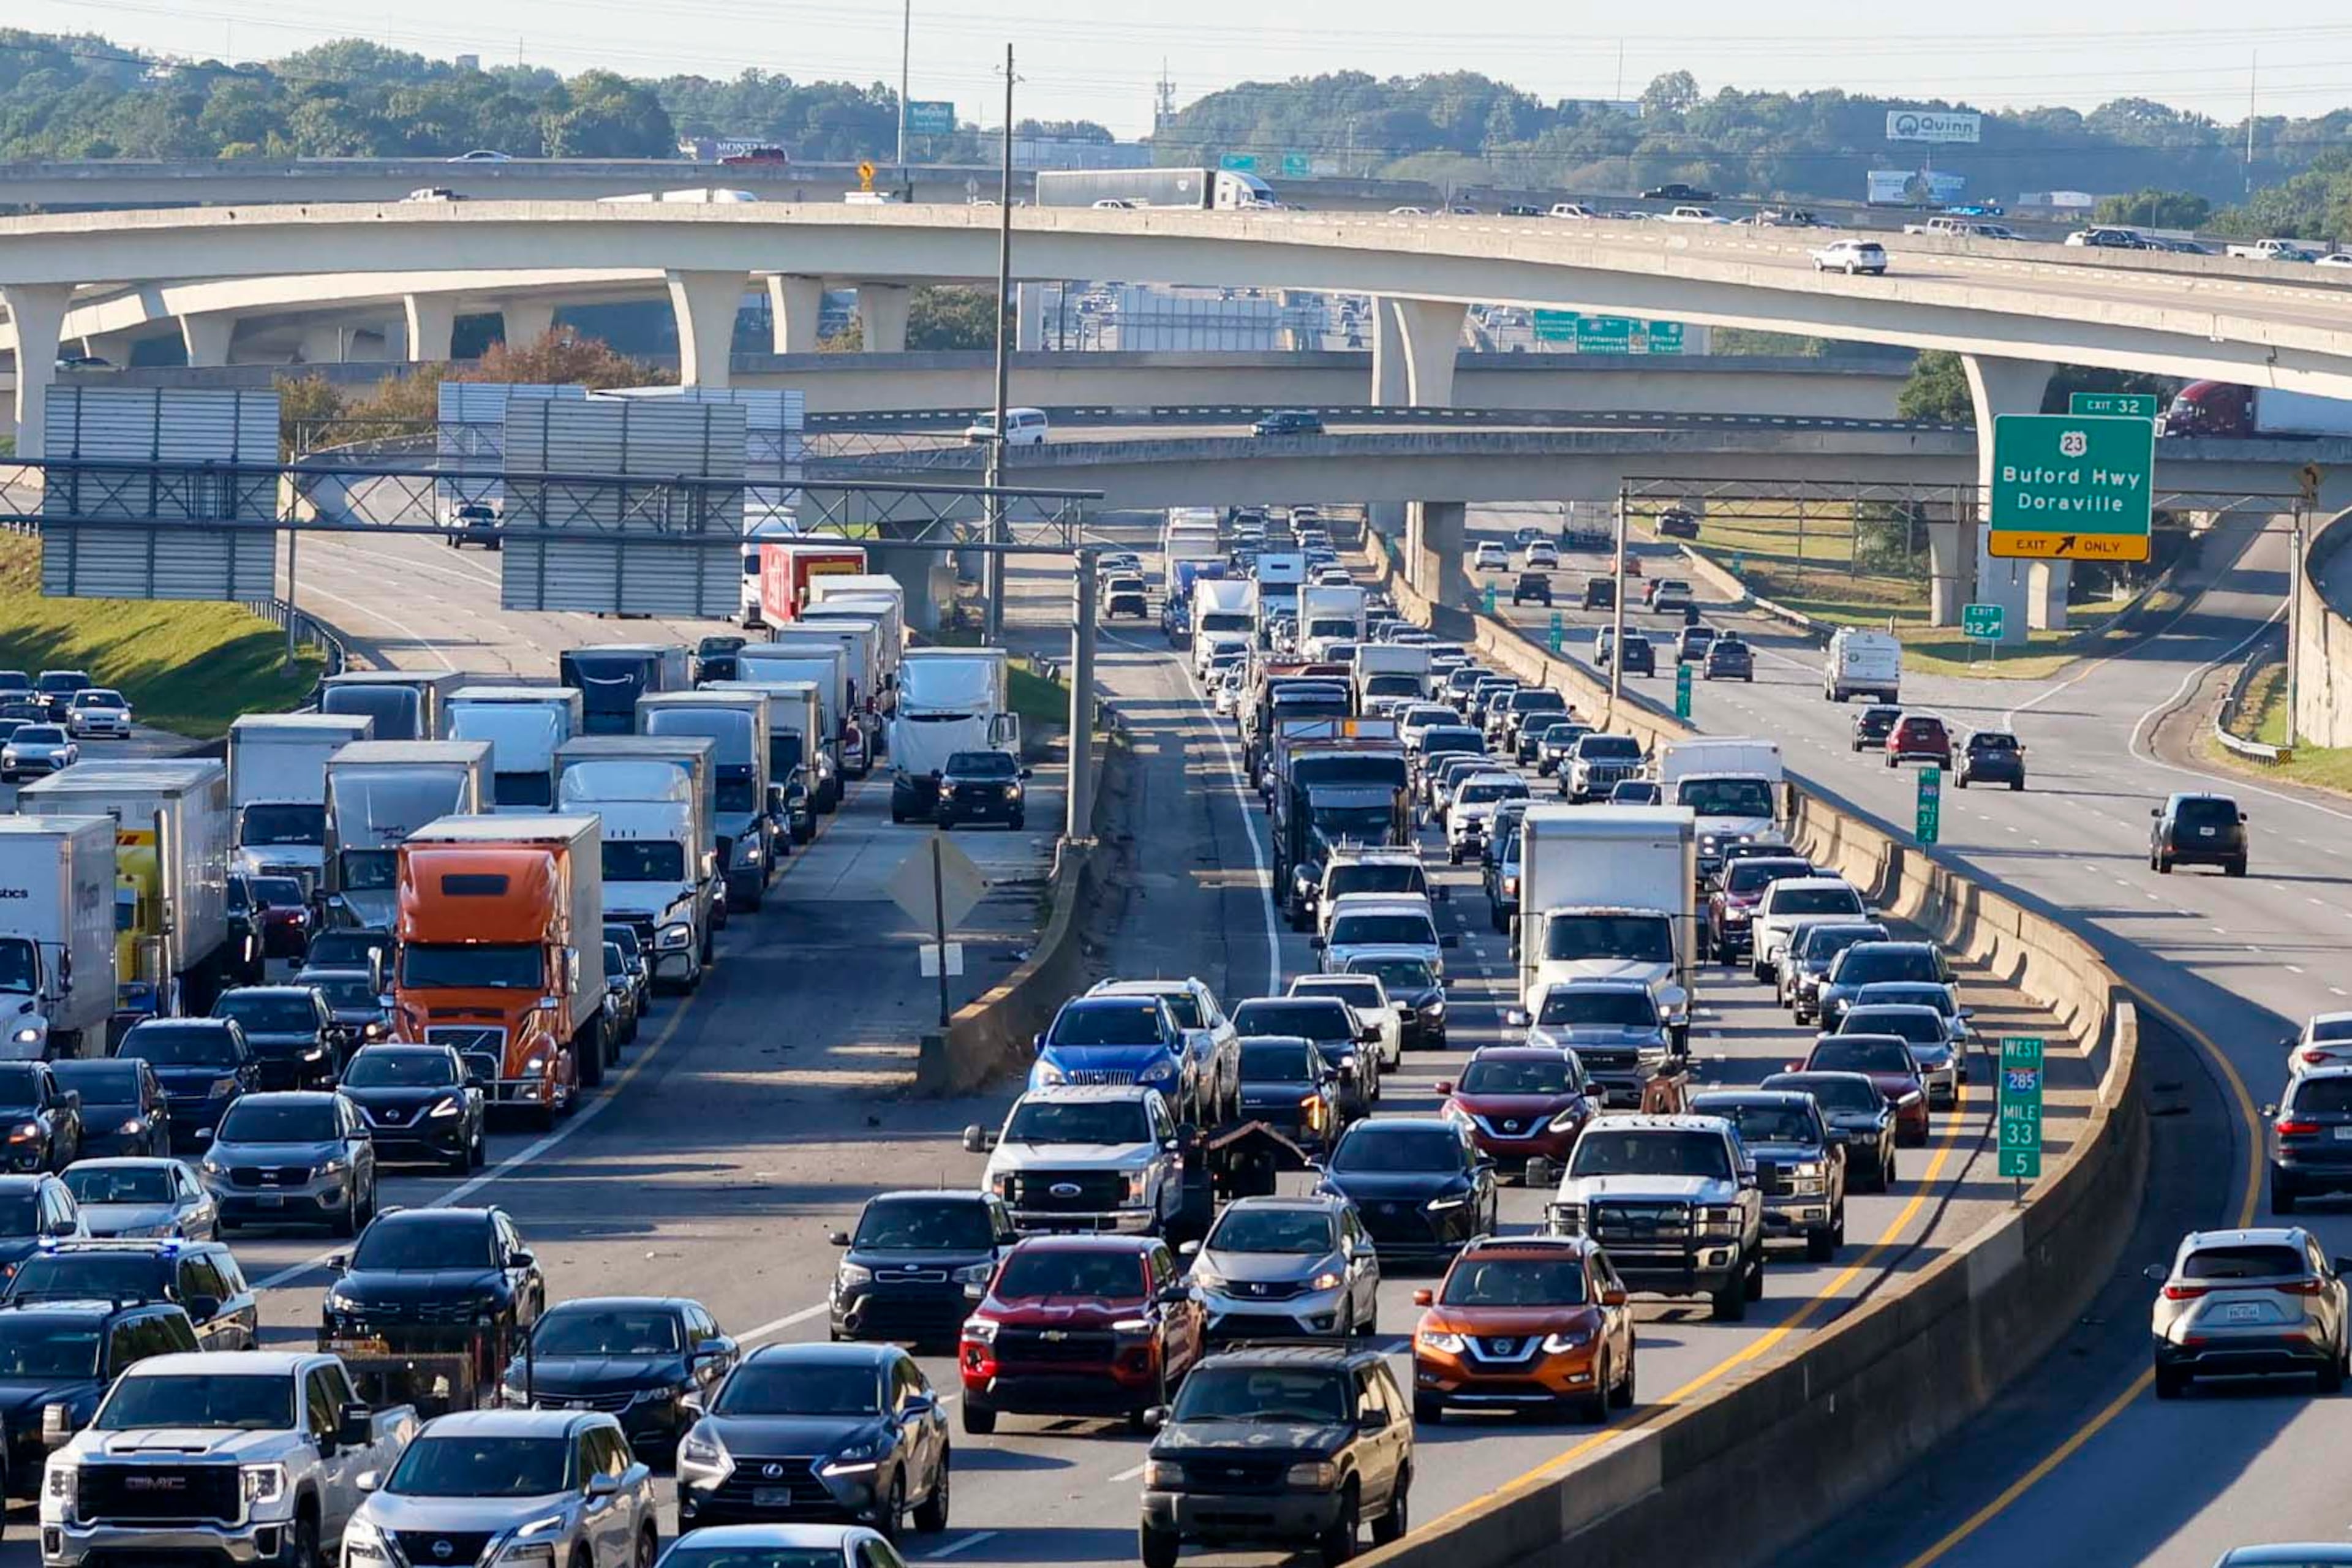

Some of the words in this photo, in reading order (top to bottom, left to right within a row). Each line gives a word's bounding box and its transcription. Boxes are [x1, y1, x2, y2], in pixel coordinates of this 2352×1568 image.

[1921, 117, 1973, 133] Quinn
[2087, 400, 2111, 410] EXIT
[2118, 399, 2139, 413] 32
[2064, 436, 2082, 451] 23
[2003, 466, 2079, 484] Buford
[2093, 469, 2140, 490] Hwy
[2018, 492, 2123, 511] Doraville
[2016, 540, 2047, 549] EXIT
[2084, 541, 2120, 552] ONLY
[1972, 607, 1994, 616] EXIT
[1965, 622, 1985, 635] 32
[2005, 1039, 2039, 1057] WEST
[2010, 1072, 2035, 1090] 285
[2003, 1105, 2037, 1121] MILE
[2007, 1123, 2032, 1144] 33
[2010, 1153, 2027, 1174] .5
[125, 1476, 186, 1491] GMC
